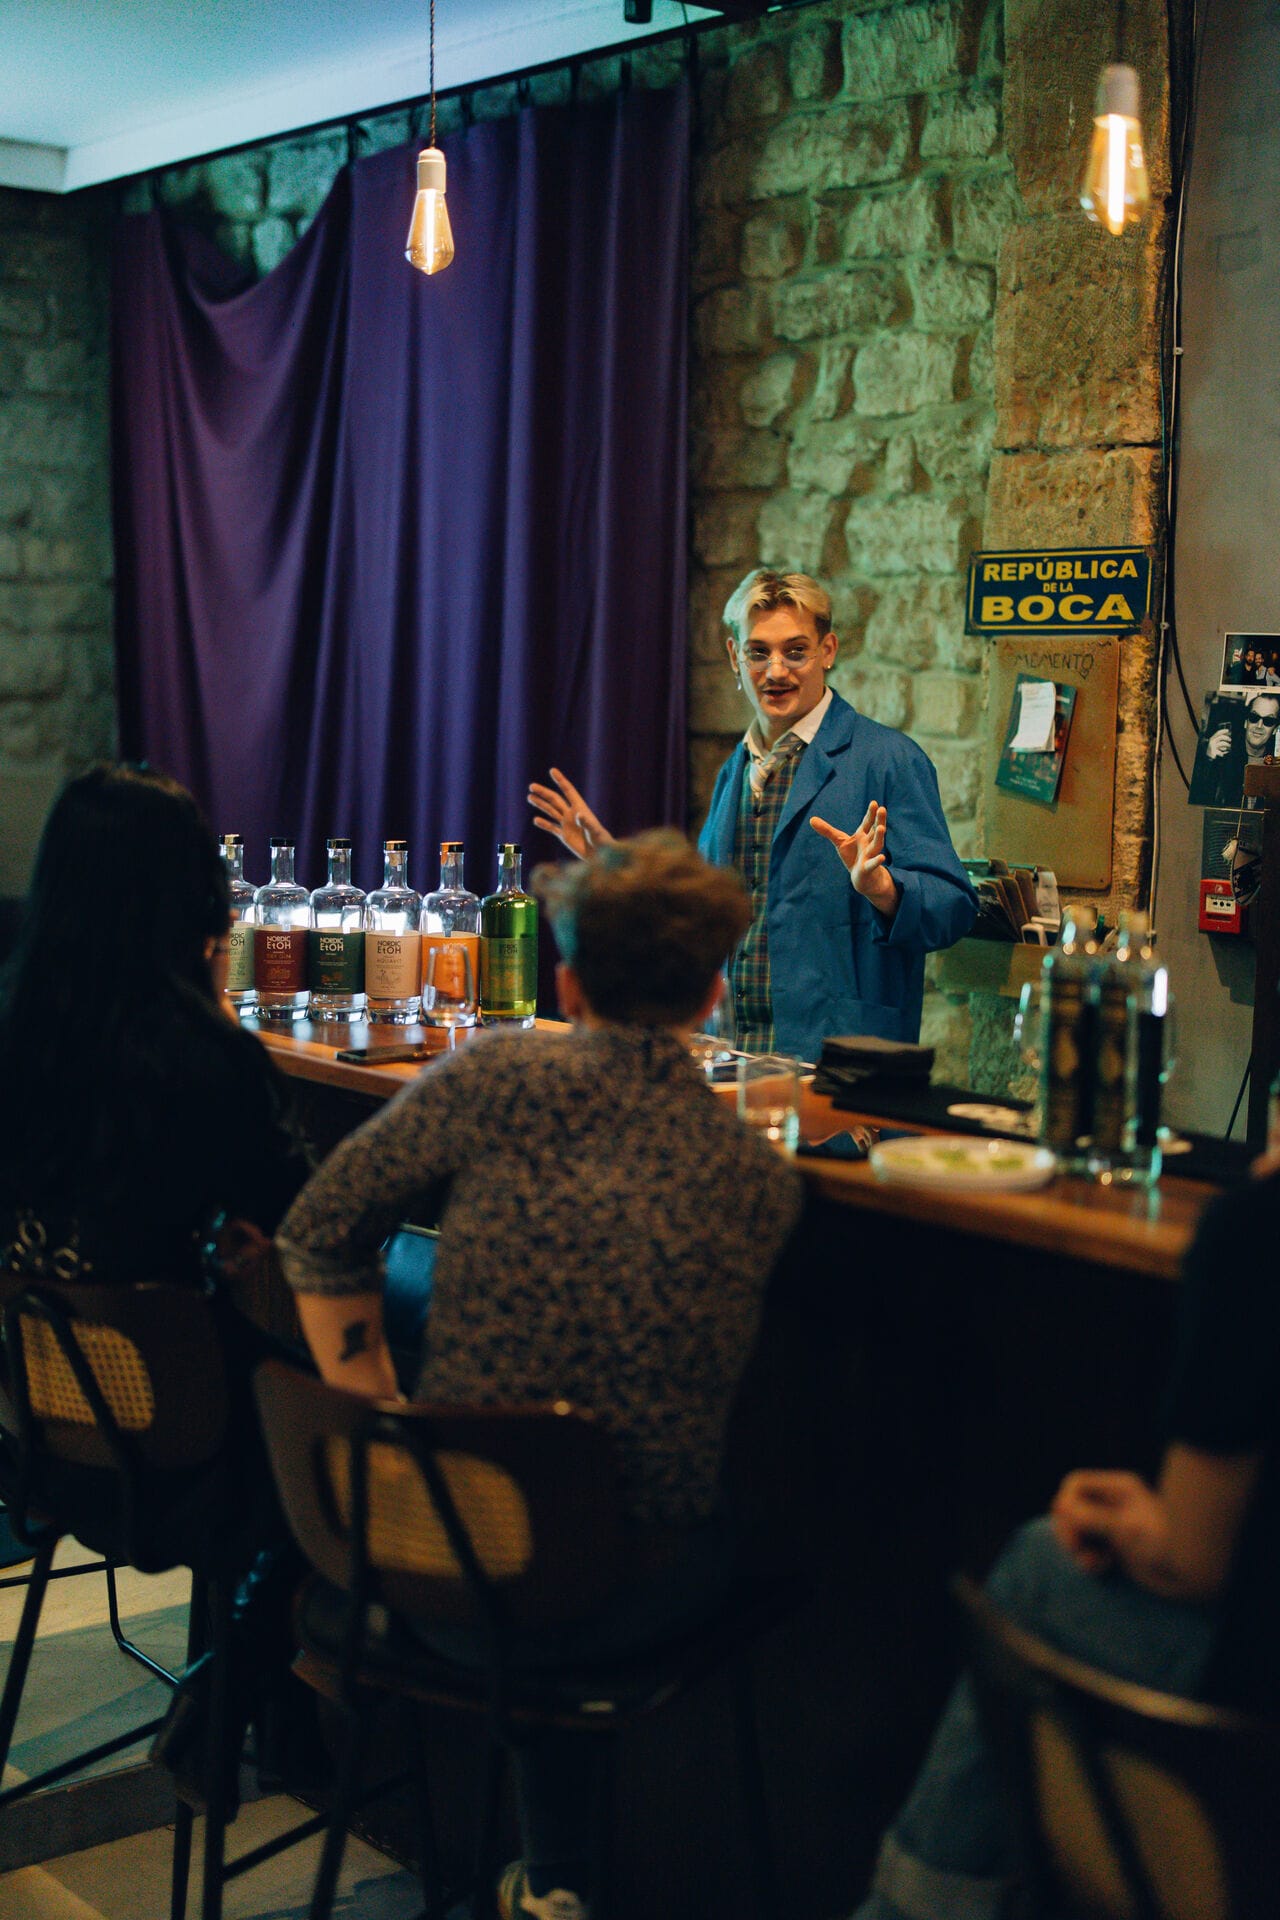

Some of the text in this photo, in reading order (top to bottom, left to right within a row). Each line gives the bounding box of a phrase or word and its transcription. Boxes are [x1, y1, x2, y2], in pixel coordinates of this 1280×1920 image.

[983, 558, 1139, 582] REPÚBLICA
[1043, 582, 1074, 593] DE LA
[981, 594, 1135, 622] BOCA
[266, 941, 291, 950] EtOH
[319, 943, 344, 951] EtOH
